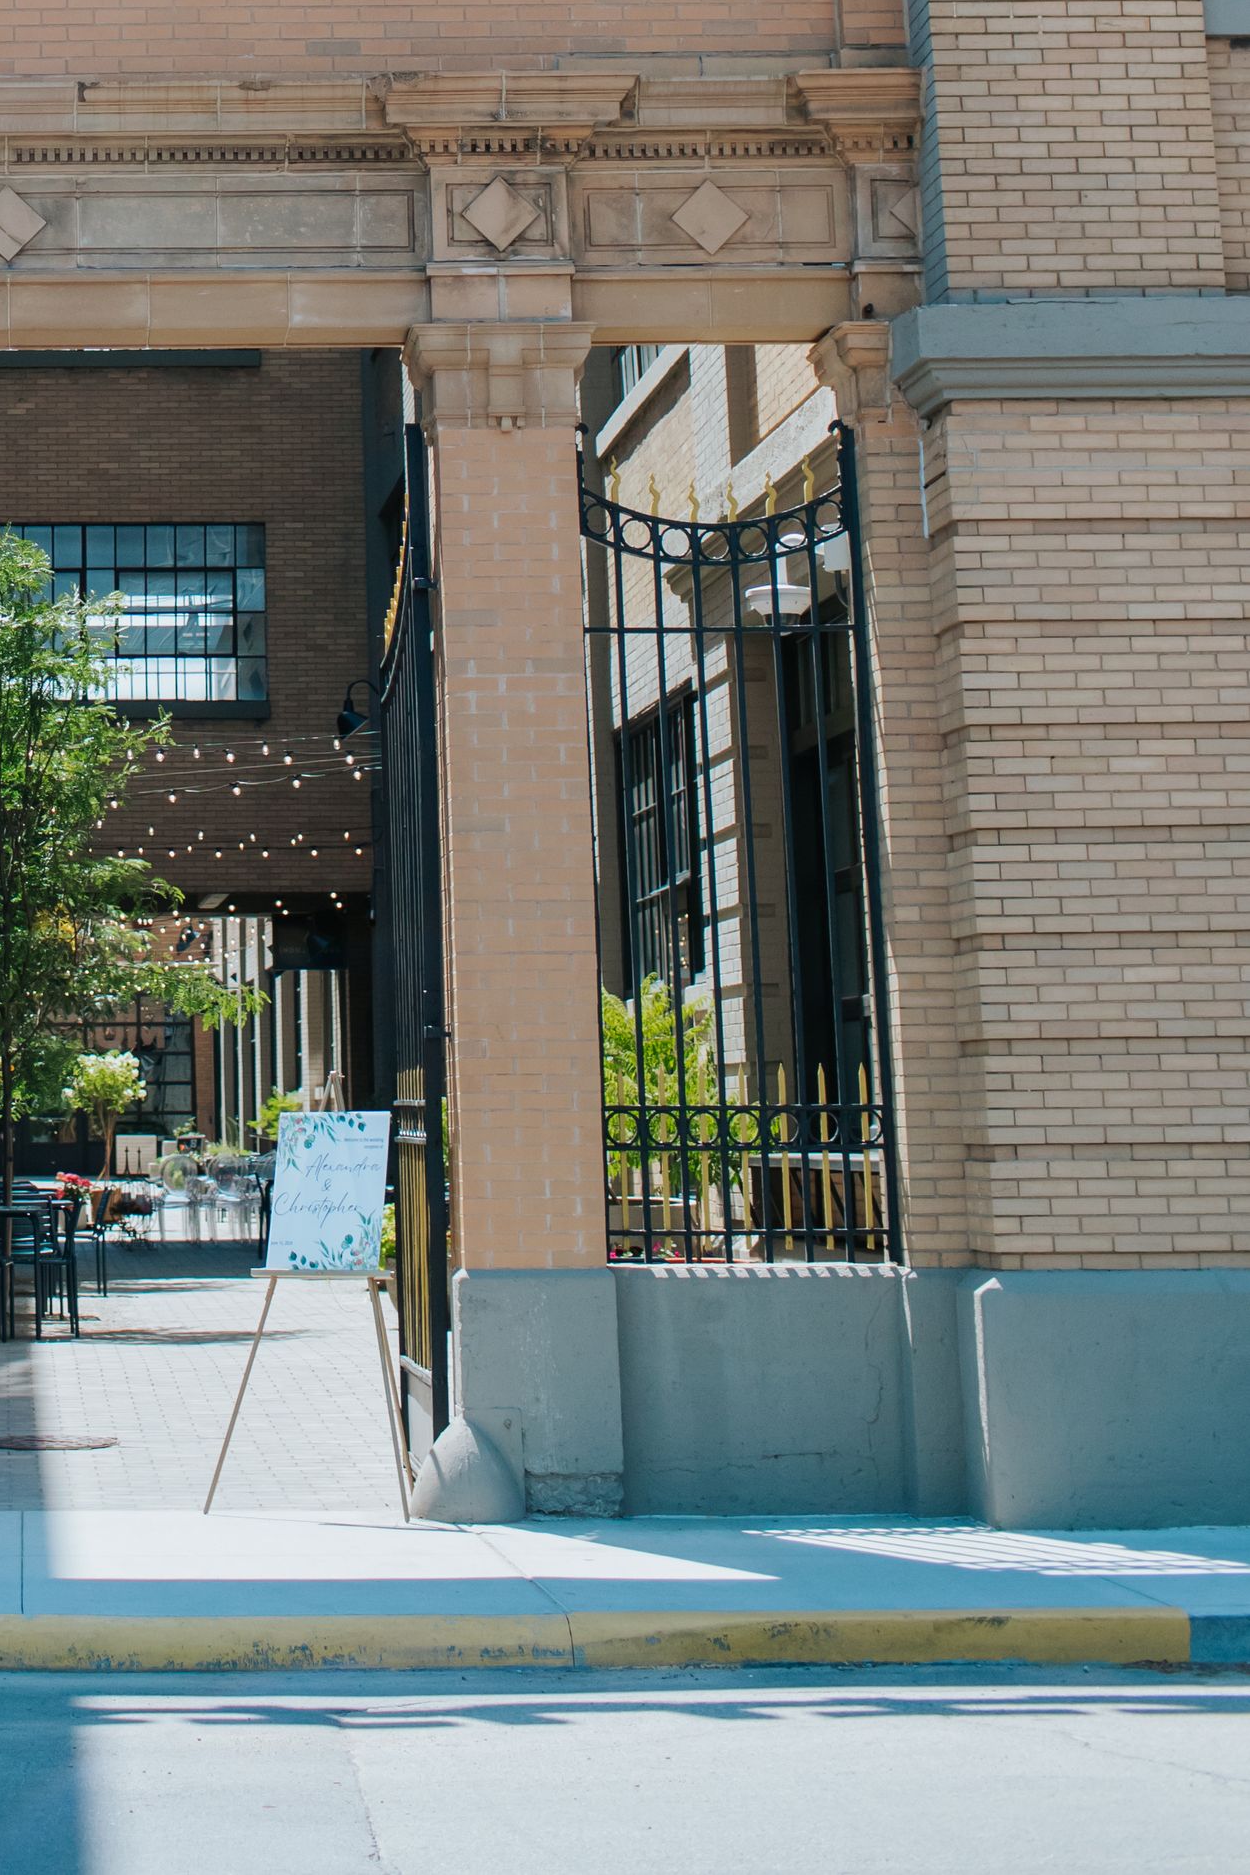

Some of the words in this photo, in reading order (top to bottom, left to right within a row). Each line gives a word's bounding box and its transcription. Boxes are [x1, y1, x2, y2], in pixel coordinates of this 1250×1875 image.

[305, 1153, 383, 1182] Alexandra
[321, 1179, 332, 1191] &
[273, 1192, 362, 1229] Christopher
